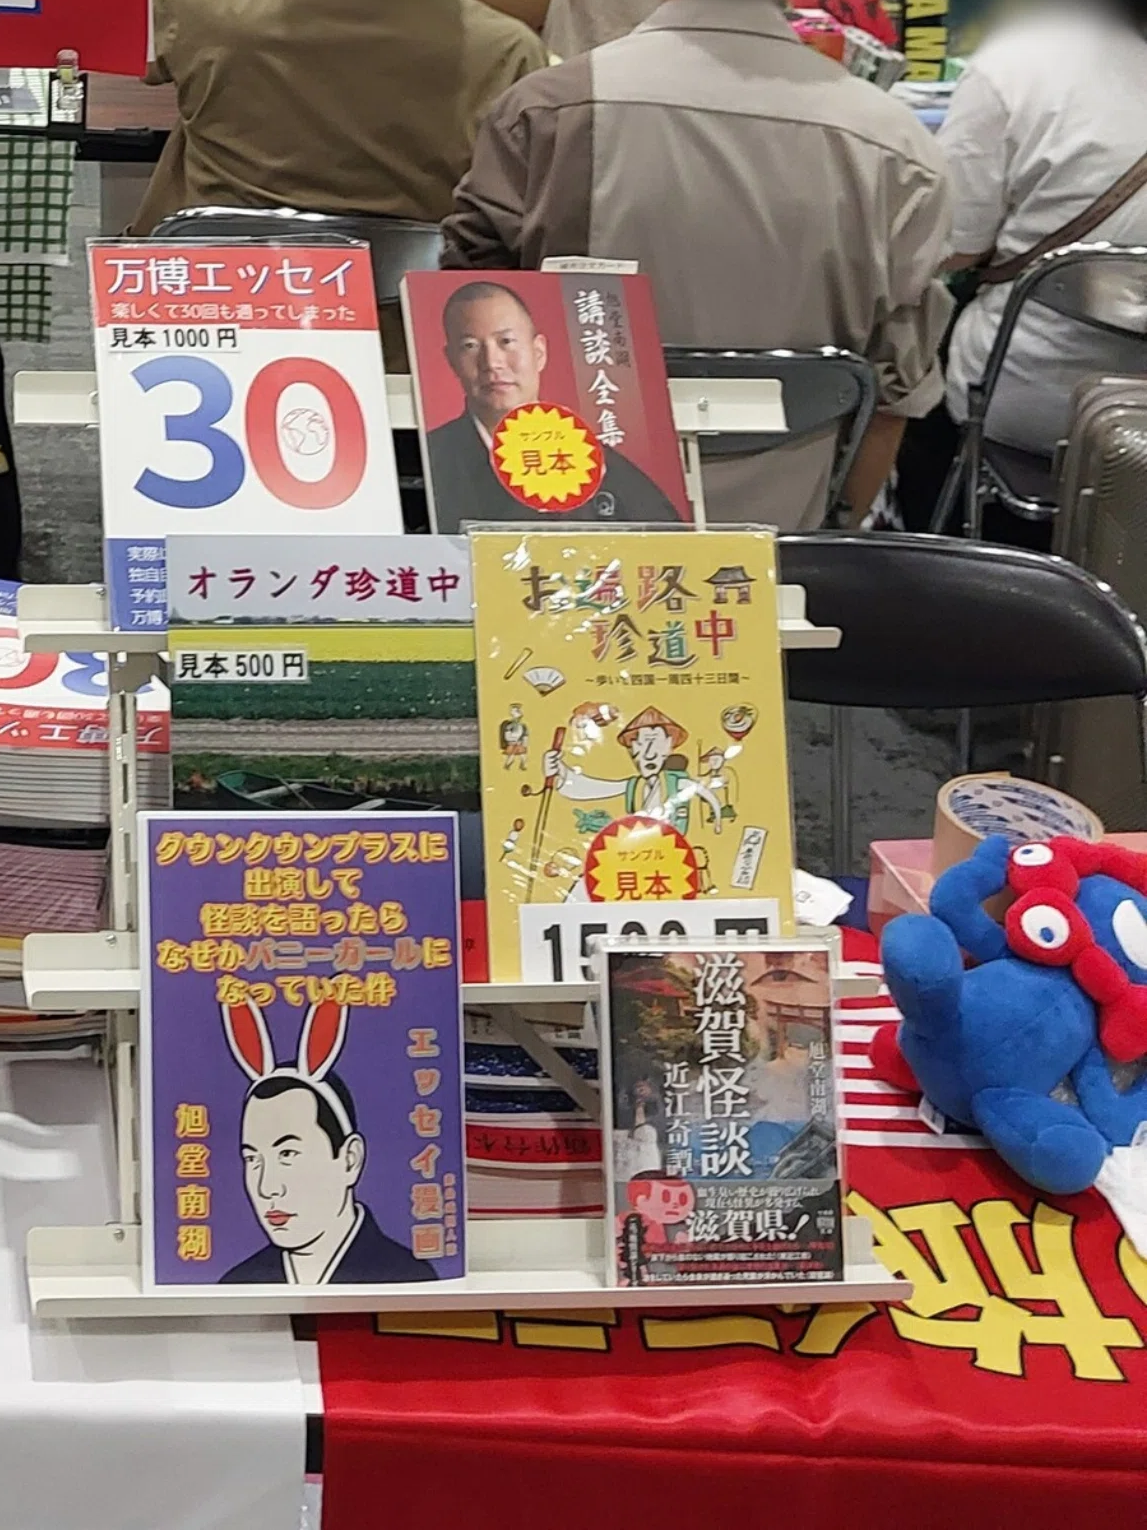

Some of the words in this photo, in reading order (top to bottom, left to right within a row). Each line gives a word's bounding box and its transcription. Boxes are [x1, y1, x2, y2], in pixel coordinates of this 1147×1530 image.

[104, 256, 353, 297] 万博エッセイ
[111, 303, 356, 322] 楽しくて30回も通ってしまった
[110, 327, 156, 349] 見本
[163, 329, 210, 348] 1000
[217, 330, 237, 348] 円
[574, 290, 626, 447] 講談全集
[131, 355, 369, 510] 30
[519, 431, 566, 442] サンプル
[521, 449, 576, 476] 見本
[188, 565, 460, 603] オランダ珍道中
[589, 609, 736, 670] 珍道中
[176, 653, 228, 678] 見本
[237, 654, 274, 677] 500
[283, 654, 304, 678] 円
[243, 868, 364, 901] 出演して
[614, 871, 672, 901] 見本
[200, 903, 407, 937] 怪談を語ったら
[156, 937, 452, 973] なぜかバニーガールに
[217, 975, 398, 1008] なっていた件
[695, 953, 752, 1177] 滋賀怪談
[664, 1061, 693, 1178] 近江奇譚
[406, 1028, 444, 1260] エッセイ漫画
[175, 1103, 212, 1261] 旭堂南湖
